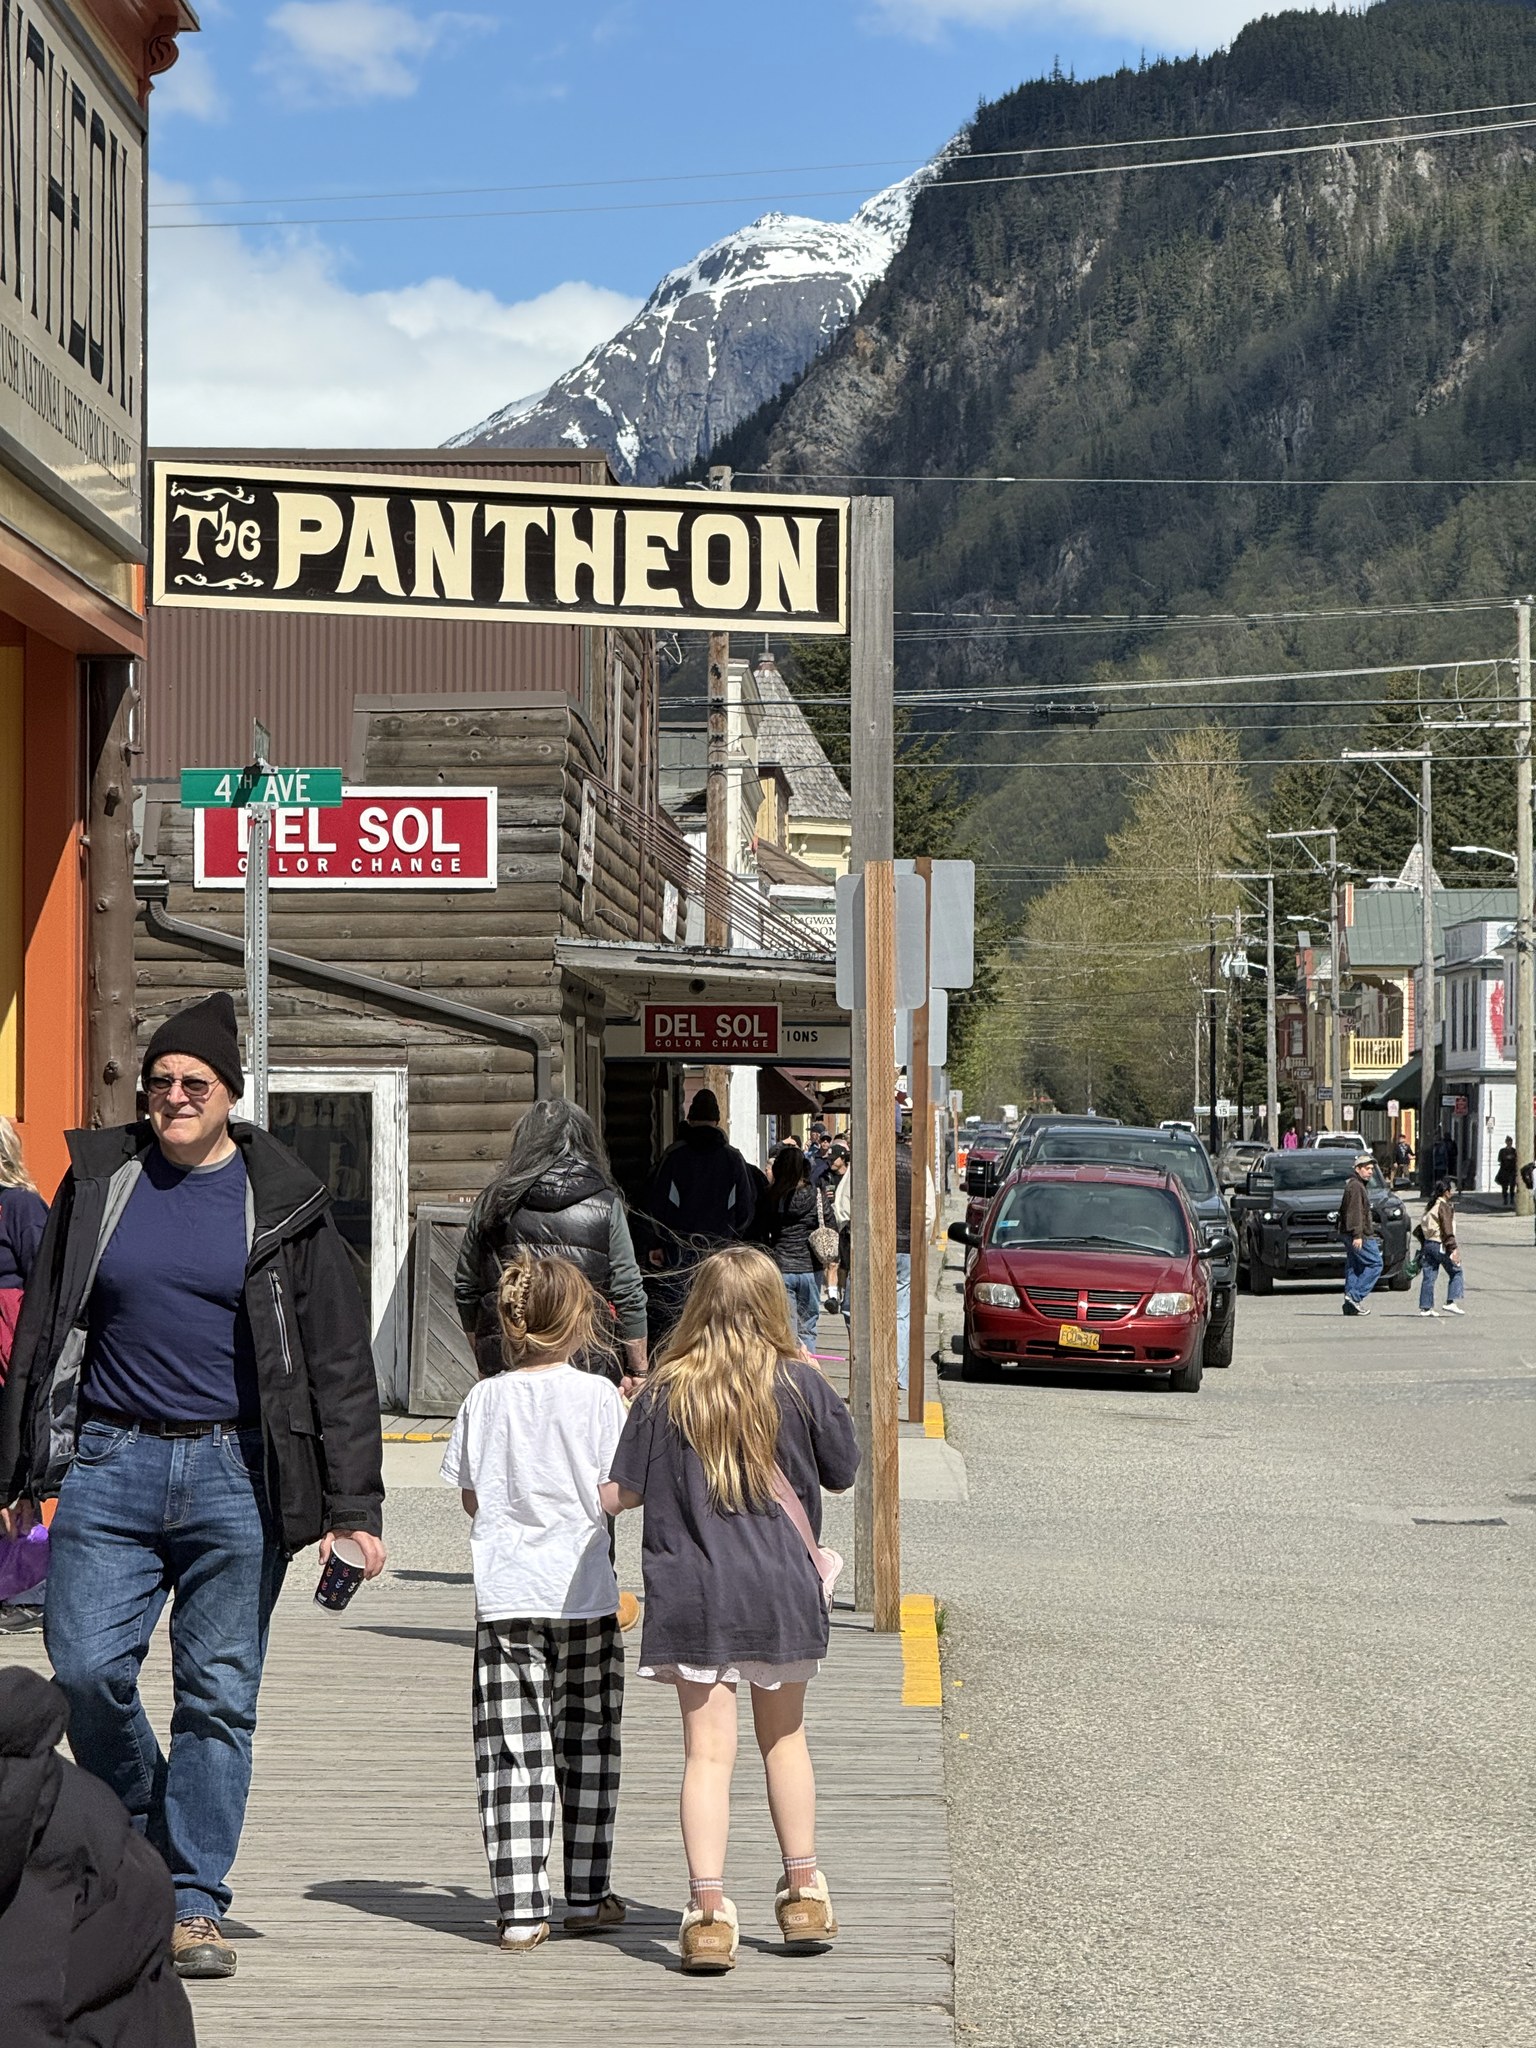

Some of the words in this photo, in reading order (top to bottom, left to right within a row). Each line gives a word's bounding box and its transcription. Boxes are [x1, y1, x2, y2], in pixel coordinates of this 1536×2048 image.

[0, 322, 19, 394] USH
[21, 342, 63, 435] NATIONAL
[64, 385, 109, 469] HISTORICAL
[173, 500, 262, 566] The
[273, 490, 822, 614] PANTHEON
[214, 774, 253, 803] 4TH
[263, 774, 311, 803] AVE
[358, 806, 461, 855] SOL
[237, 858, 329, 873] CLOR
[351, 858, 462, 873] CHANGE
[654, 1013, 705, 1037] DEL
[716, 1013, 769, 1038] SOL
[782, 1029, 819, 1042] IONS
[655, 1039, 702, 1048] COLOR
[712, 1039, 769, 1048] CHANGE
[1218, 1108, 1228, 1116] 15
